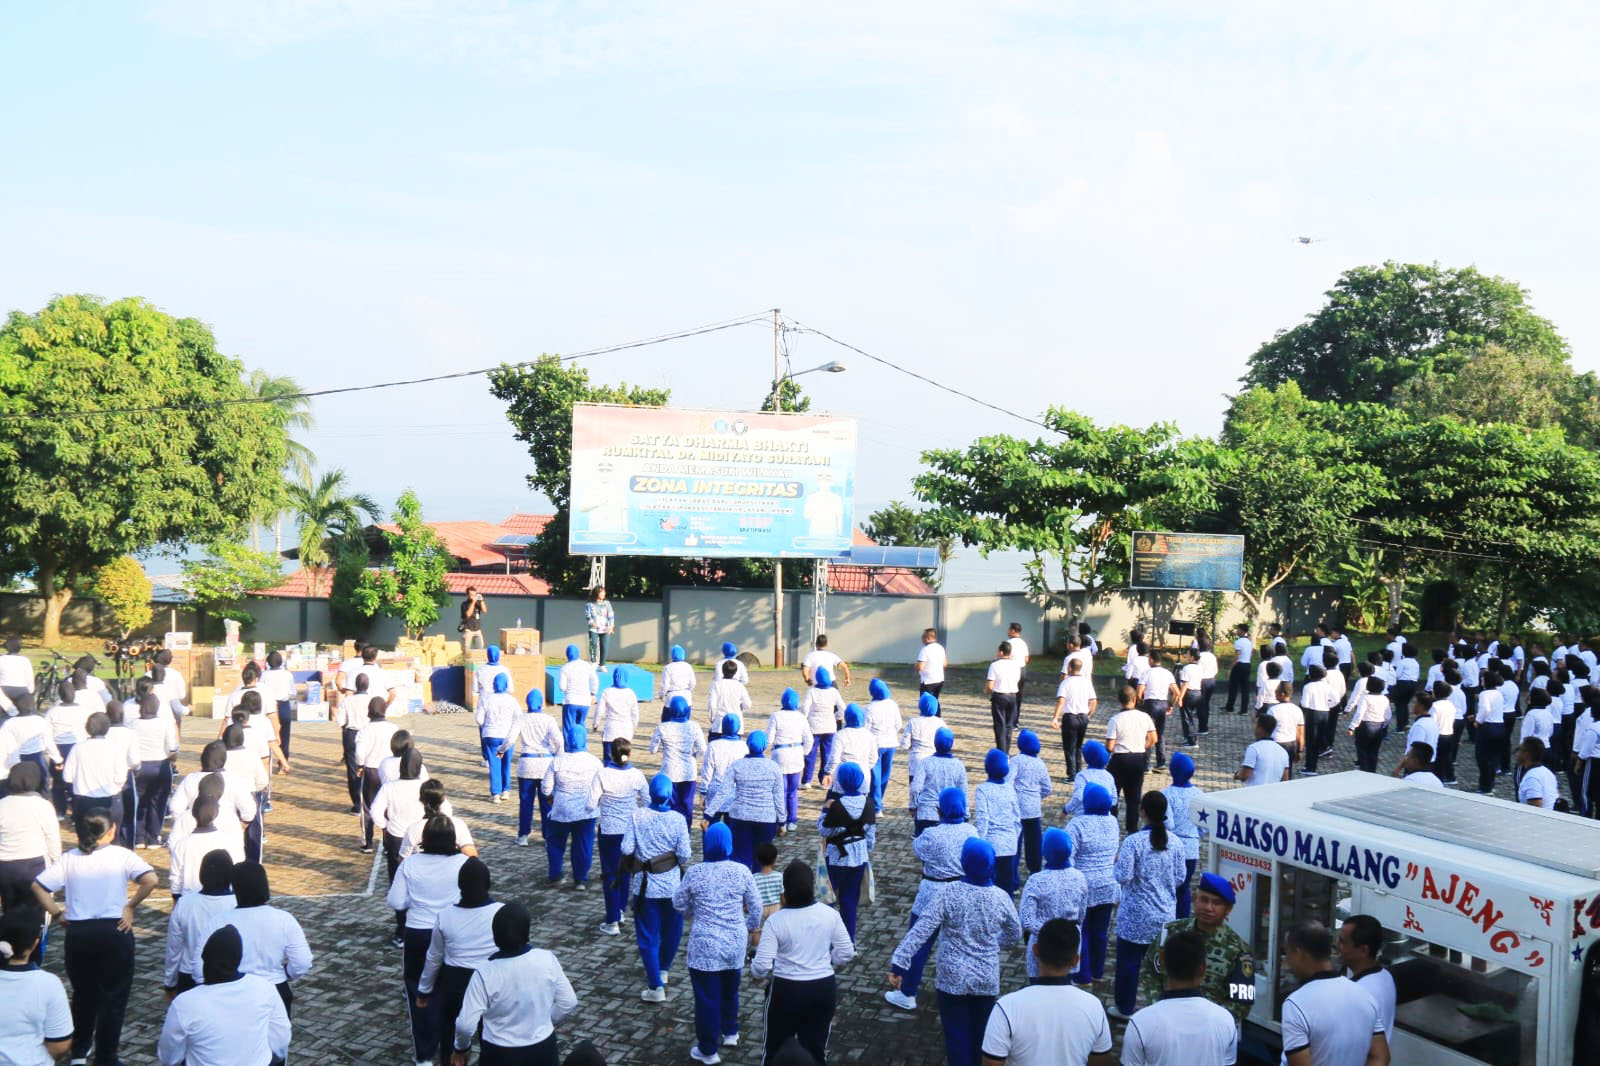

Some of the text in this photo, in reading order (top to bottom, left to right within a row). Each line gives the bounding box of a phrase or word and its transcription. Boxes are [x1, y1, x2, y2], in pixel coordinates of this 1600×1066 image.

[631, 433, 809, 454] SATYA DHARMA BHAKTI
[601, 447, 674, 460] RUMKITAL
[699, 452, 764, 464] MIDIYATO
[768, 456, 831, 467] SURATANI
[634, 478, 798, 498] ZONA INTEGRITAS
[1216, 810, 1289, 857] BAKSO
[1294, 830, 1401, 888] MALANG
